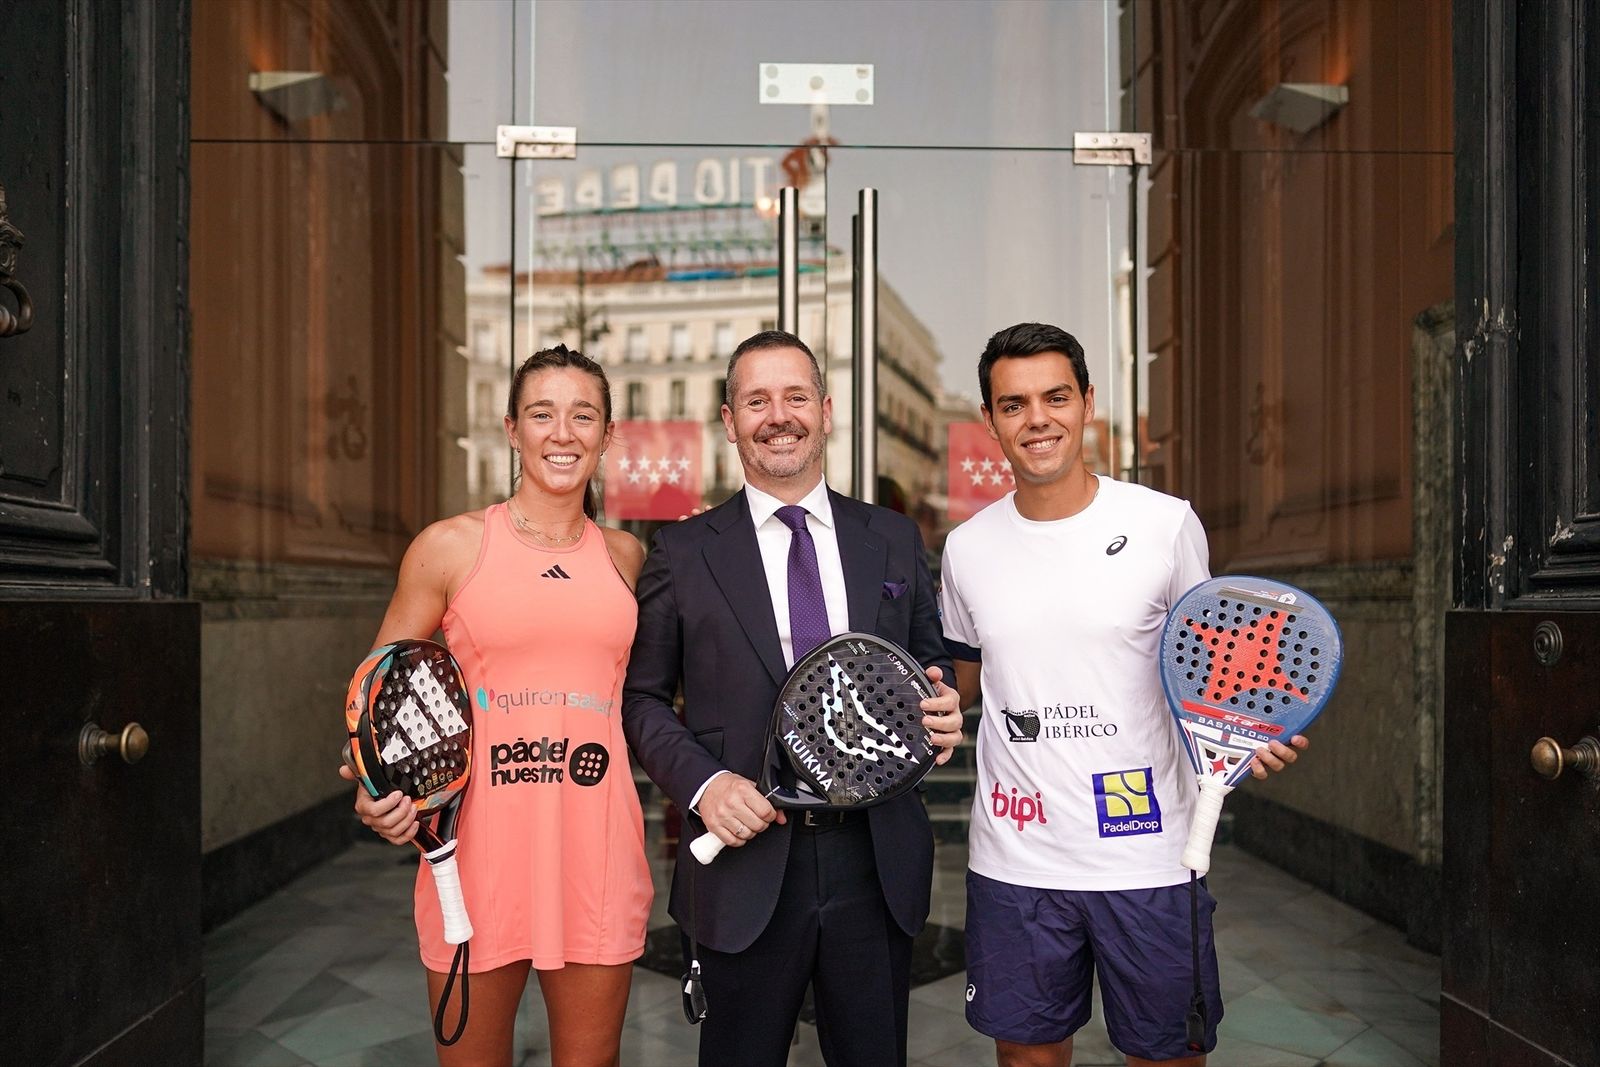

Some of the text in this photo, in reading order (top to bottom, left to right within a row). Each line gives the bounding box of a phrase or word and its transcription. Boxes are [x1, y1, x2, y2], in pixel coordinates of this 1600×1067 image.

[894, 661, 908, 676] PRO
[1043, 704, 1099, 720] PÁDEL
[1045, 722, 1118, 739] IBÉRICO
[1197, 716, 1257, 737] BASALTO
[782, 729, 833, 792] KUIKMA
[991, 782, 1047, 832] bipi
[1103, 819, 1160, 833] PadelDrop
